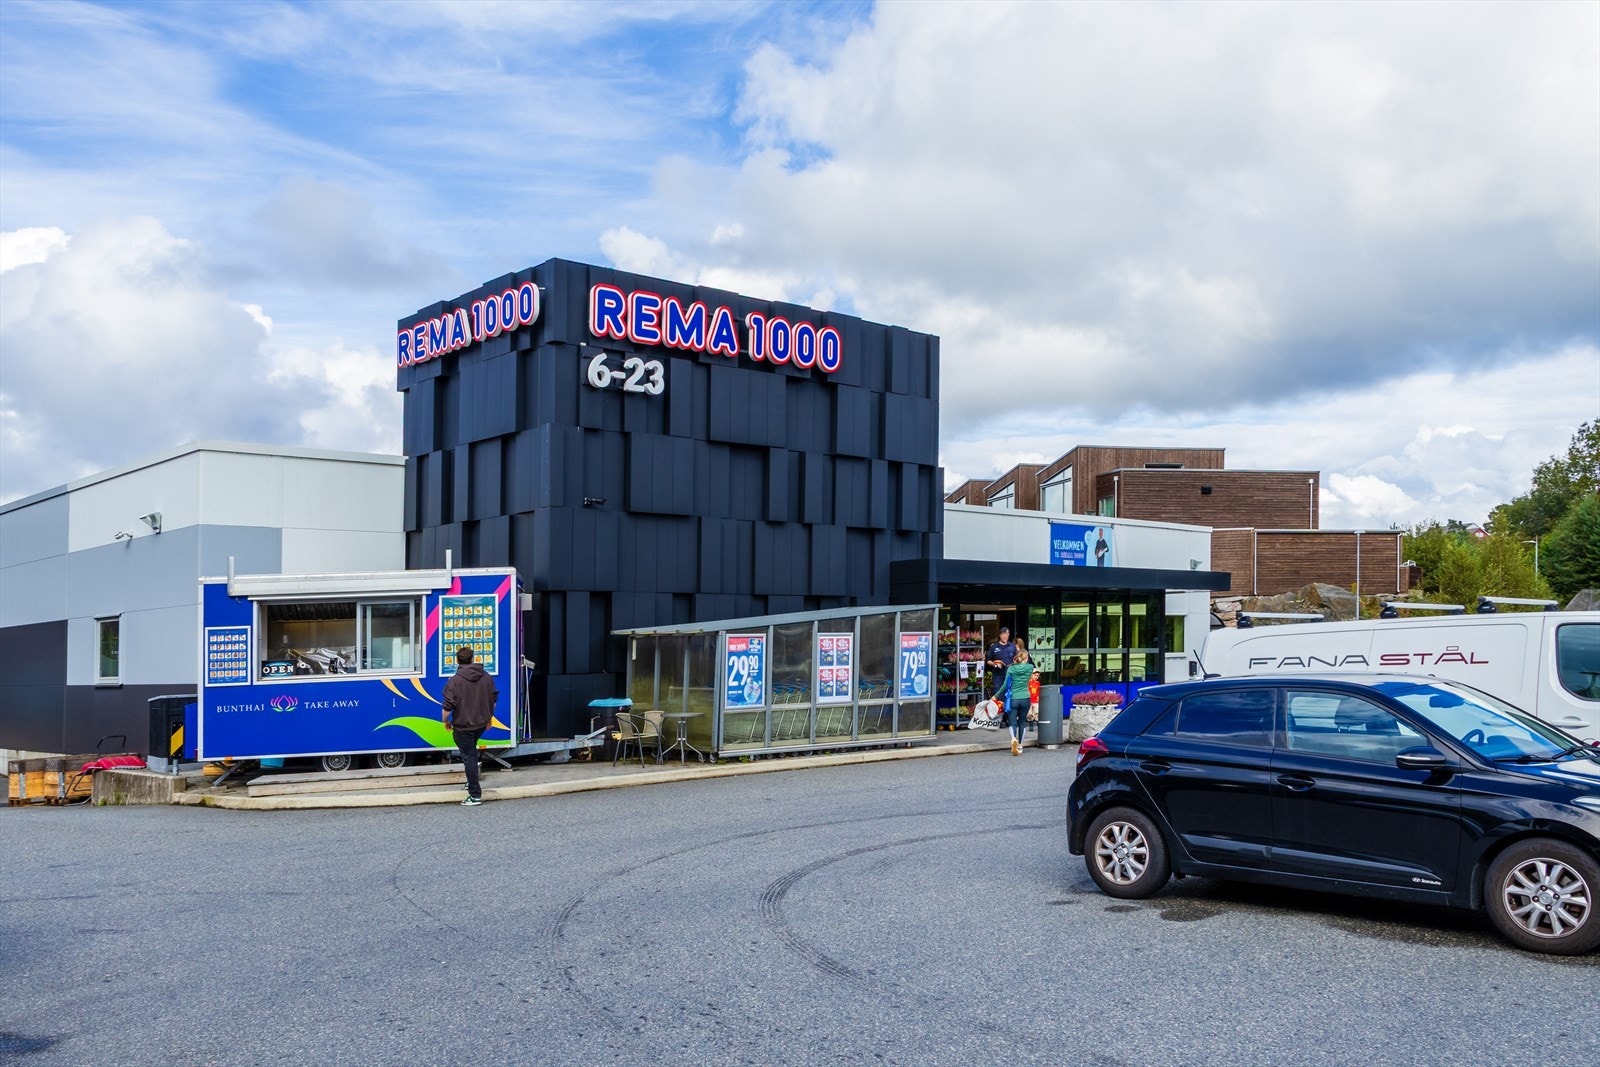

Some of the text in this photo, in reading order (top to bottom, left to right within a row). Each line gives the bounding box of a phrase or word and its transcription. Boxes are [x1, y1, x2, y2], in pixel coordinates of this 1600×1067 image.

[398, 281, 540, 368] REMA 1000
[589, 283, 842, 373] REMA 1000
[588, 352, 665, 395] 6-23
[1053, 539, 1084, 551] VELKOMMEN
[262, 665, 295, 675] OPEN
[728, 655, 759, 686] 29 90
[902, 651, 918, 679] 79
[1249, 646, 1489, 669] FANA STÅL
[216, 699, 360, 713] BUNTHAI TAKE AWAY
